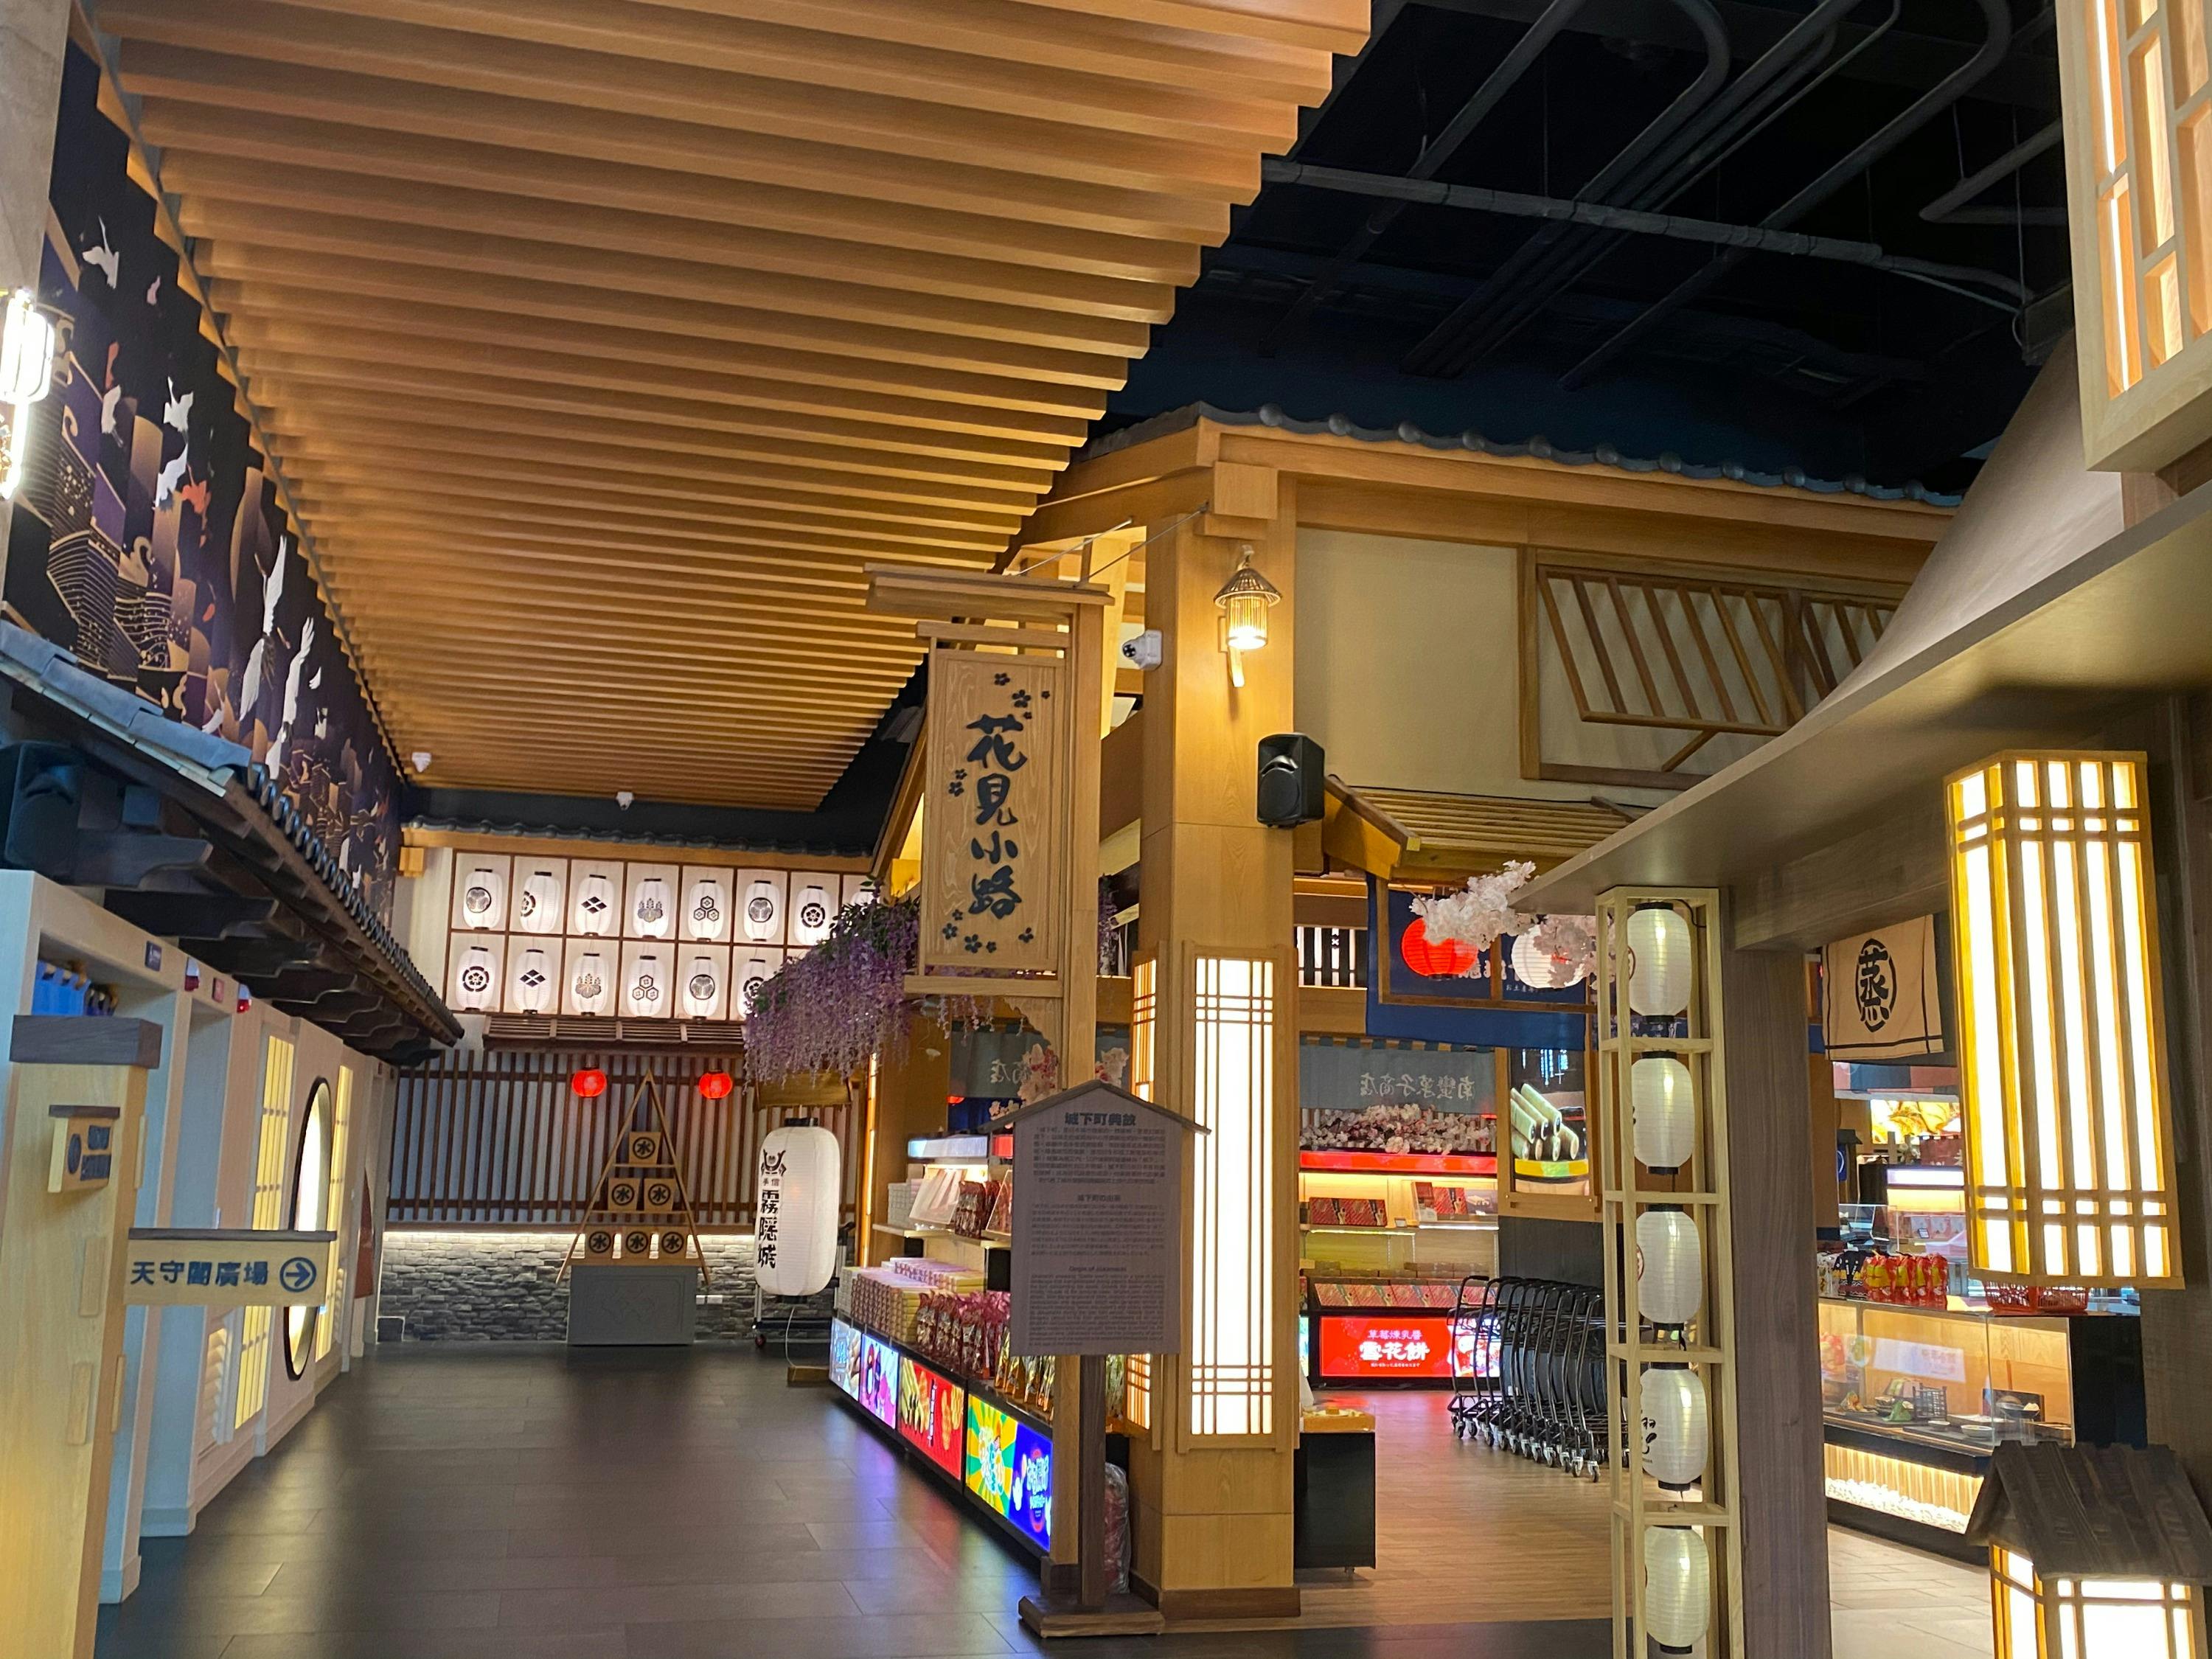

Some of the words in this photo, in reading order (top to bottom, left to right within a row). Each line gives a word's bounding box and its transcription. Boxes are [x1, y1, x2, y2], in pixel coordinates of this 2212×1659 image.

[966, 714, 1028, 920] 花見小路
[1858, 947, 1890, 1022] 蒸
[131, 1260, 268, 1287] 天守閣廣場
[1359, 1340, 1430, 1361] 雪花餅
